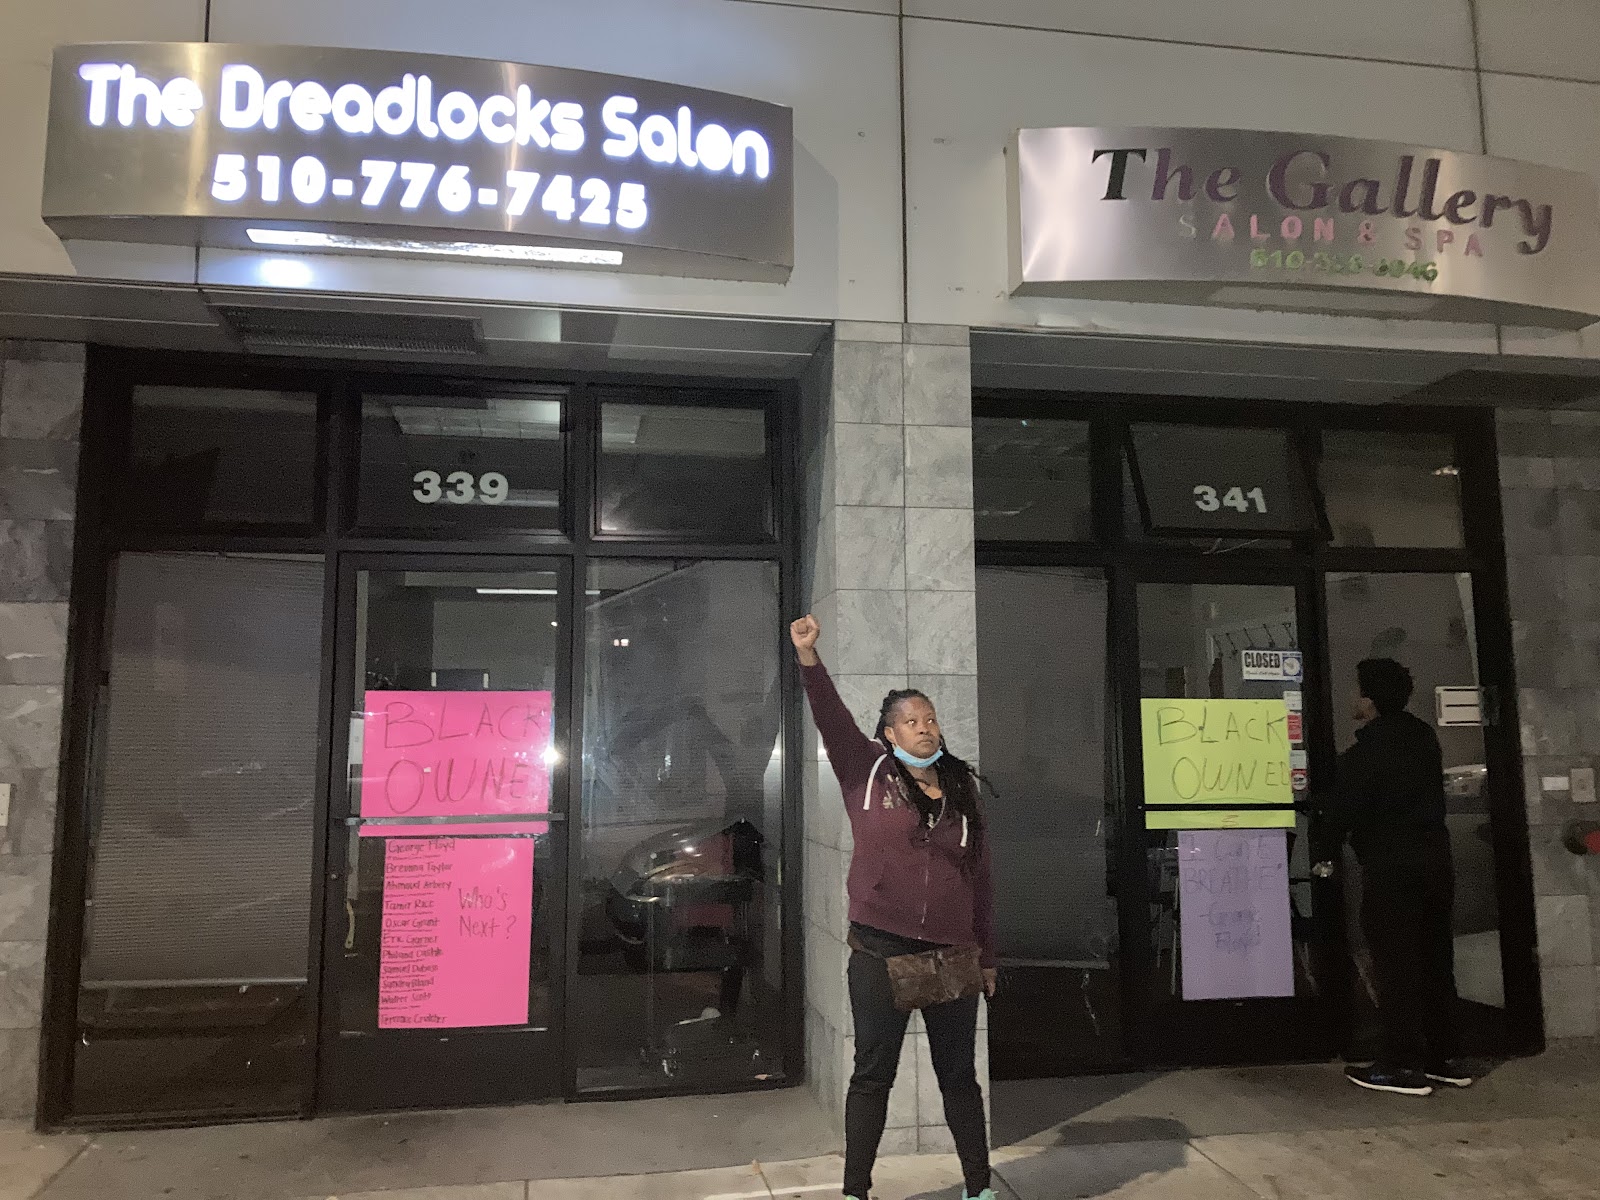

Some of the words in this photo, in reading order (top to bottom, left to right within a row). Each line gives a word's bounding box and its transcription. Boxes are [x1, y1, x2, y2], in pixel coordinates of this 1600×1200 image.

[79, 62, 203, 127] The
[218, 64, 586, 152] Dreadlocks
[602, 96, 770, 179] Salon
[211, 154, 648, 229] 510-776-7425
[1091, 148, 1241, 201] The
[1266, 150, 1553, 255] Gallery
[1178, 213, 1335, 242] SALON
[1358, 219, 1377, 246] &
[1404, 226, 1484, 257] SPA
[412, 470, 509, 505] 339
[1193, 485, 1267, 513] 341
[1244, 652, 1281, 669] CLOSED
[384, 698, 546, 748] BLACK
[1157, 706, 1286, 750] BLACK
[384, 758, 540, 814] OWNE
[1172, 756, 1290, 799] OWNED
[458, 886, 508, 912] Who's
